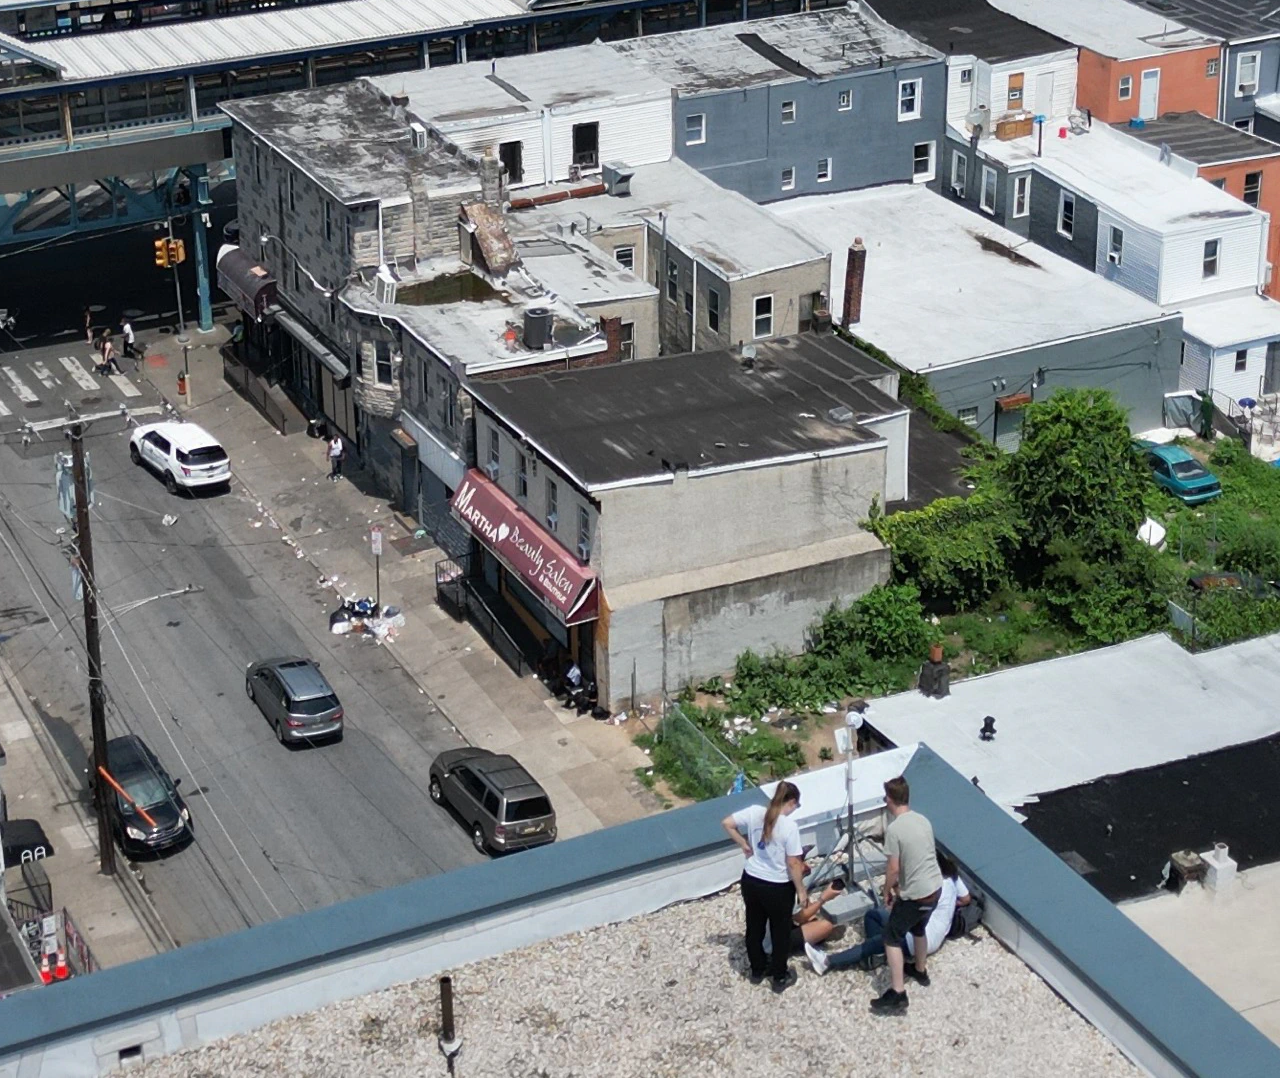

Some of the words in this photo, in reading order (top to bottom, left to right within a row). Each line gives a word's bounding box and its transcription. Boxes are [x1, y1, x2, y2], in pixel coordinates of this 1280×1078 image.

[454, 481, 496, 543] MARTHA
[509, 526, 544, 576] Beauty
[543, 559, 573, 595] Salon
[21, 846, 46, 864] AA
